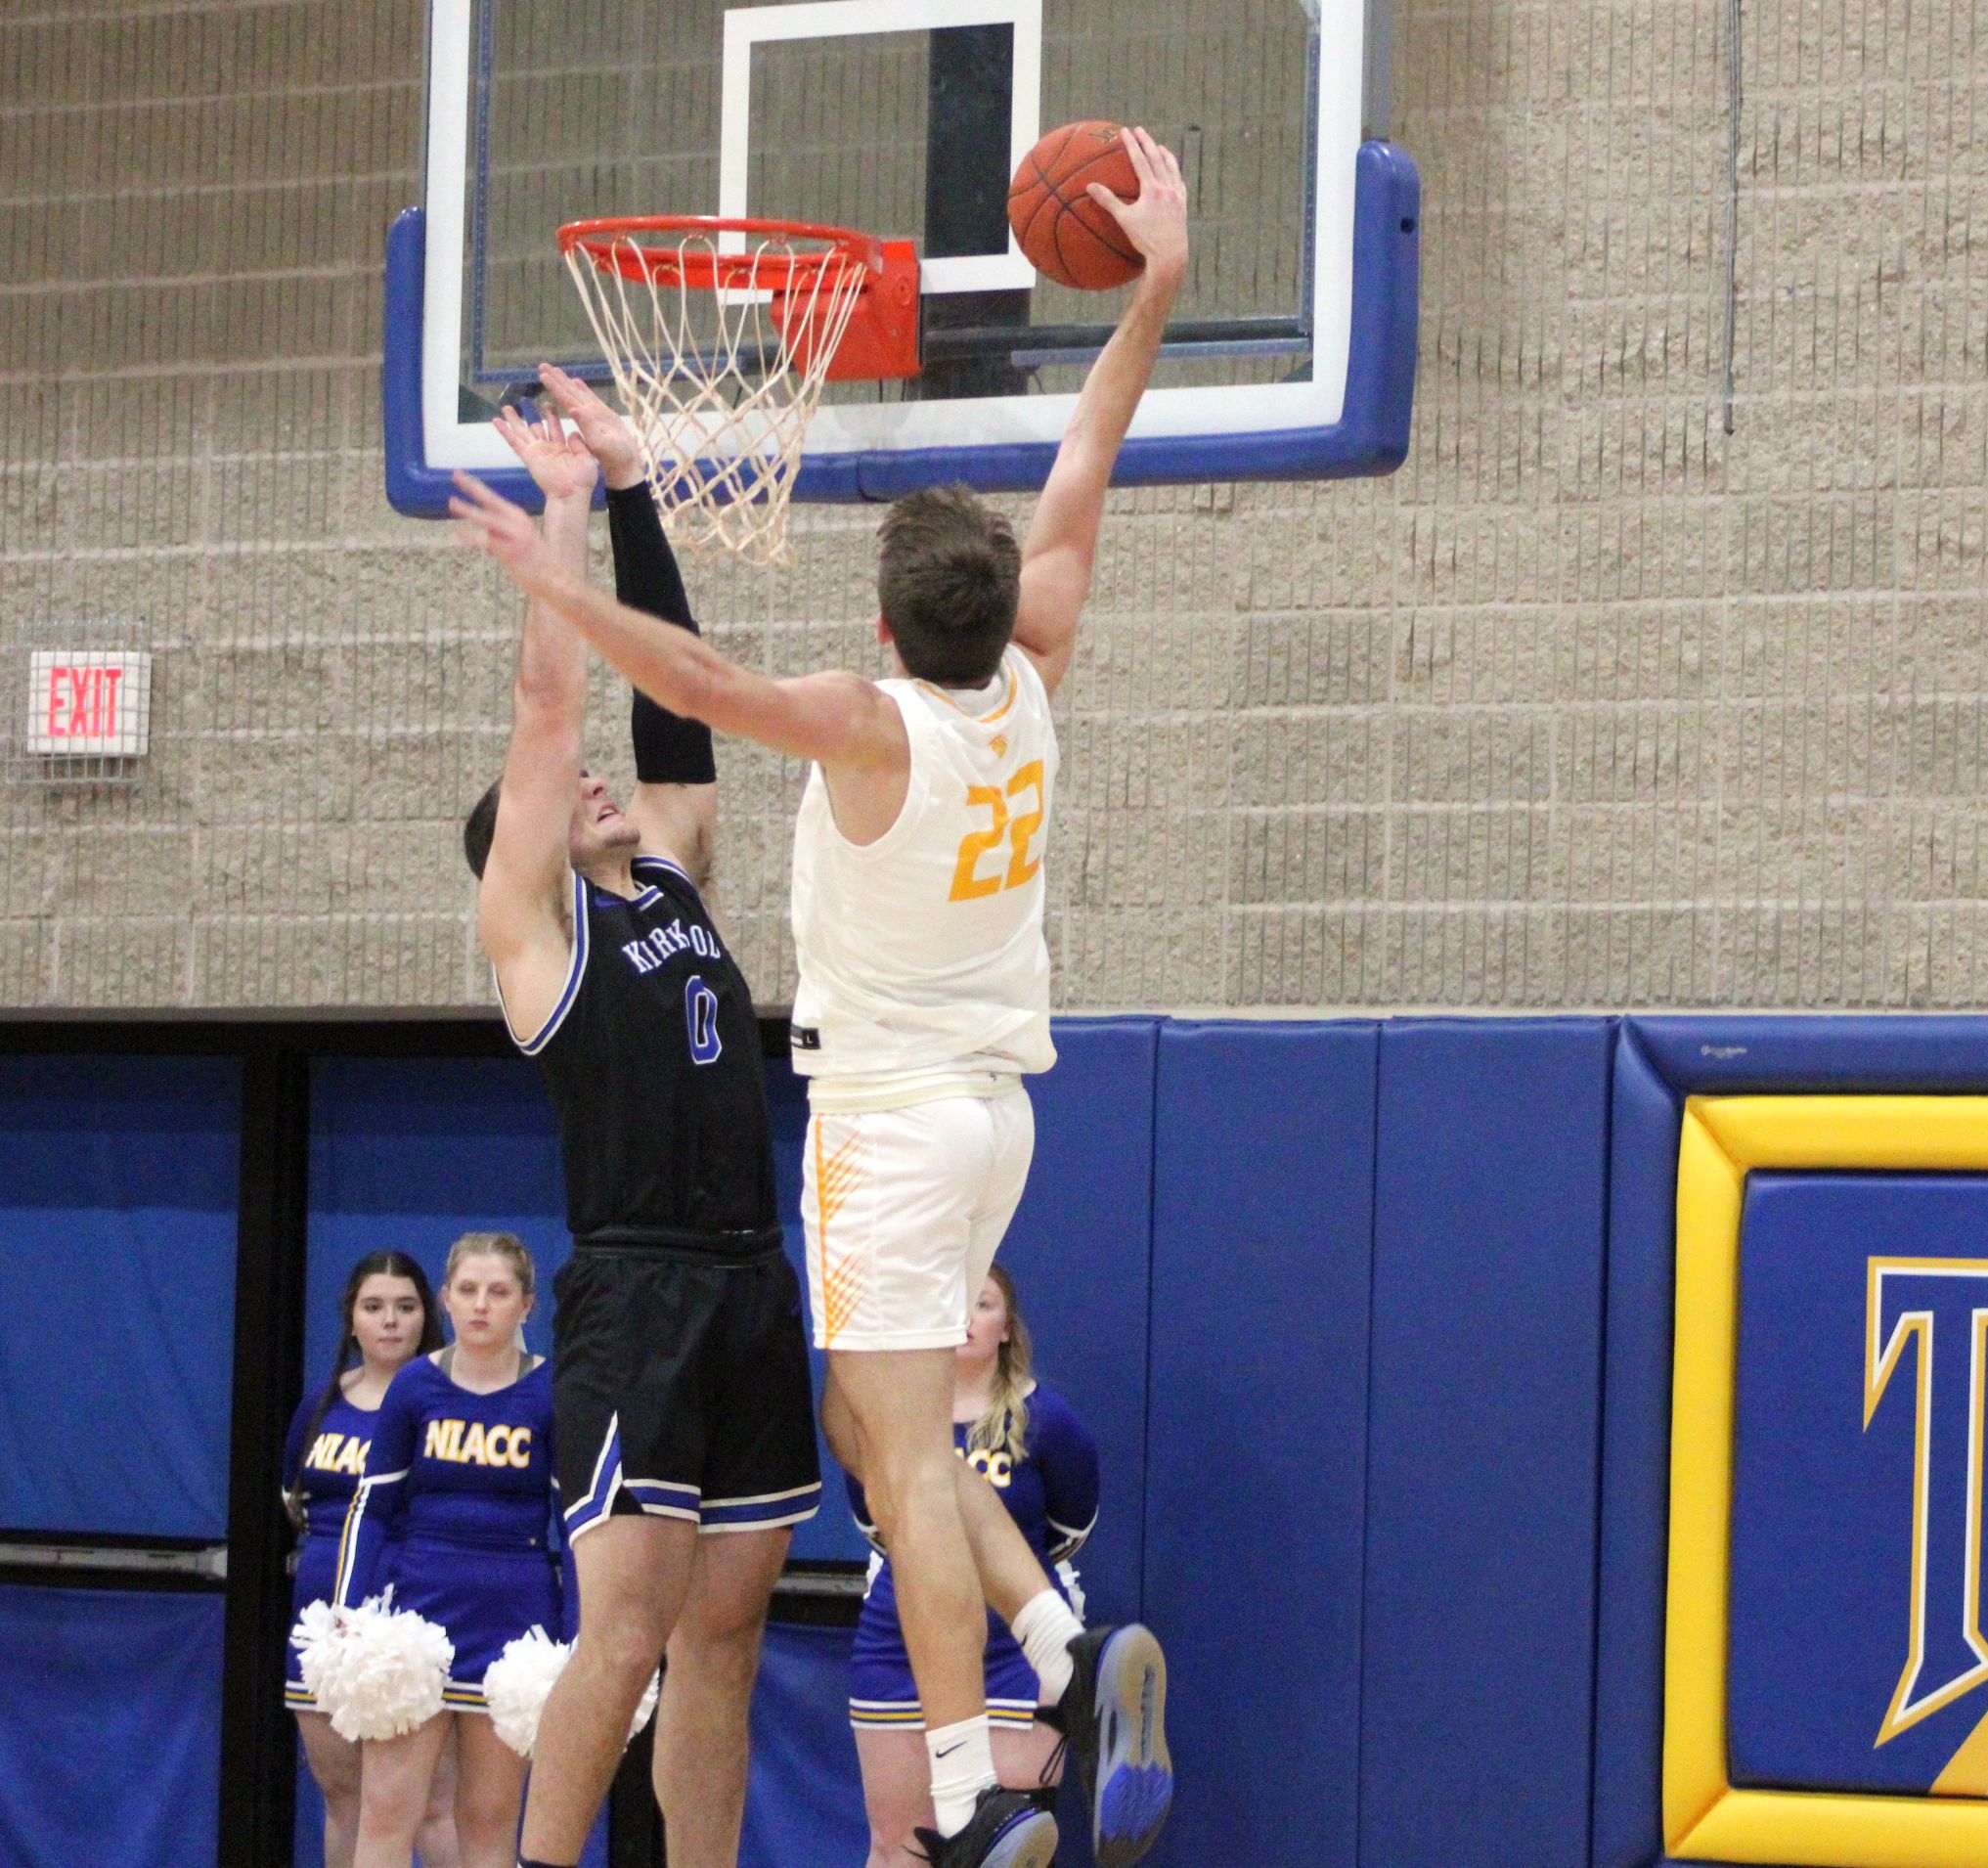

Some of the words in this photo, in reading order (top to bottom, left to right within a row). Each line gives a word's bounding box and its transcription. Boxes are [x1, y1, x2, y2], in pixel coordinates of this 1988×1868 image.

[48, 667, 123, 738] EXIT
[949, 759, 1045, 902] 22
[685, 975, 722, 1065] 0
[423, 1418, 532, 1468] NIACC
